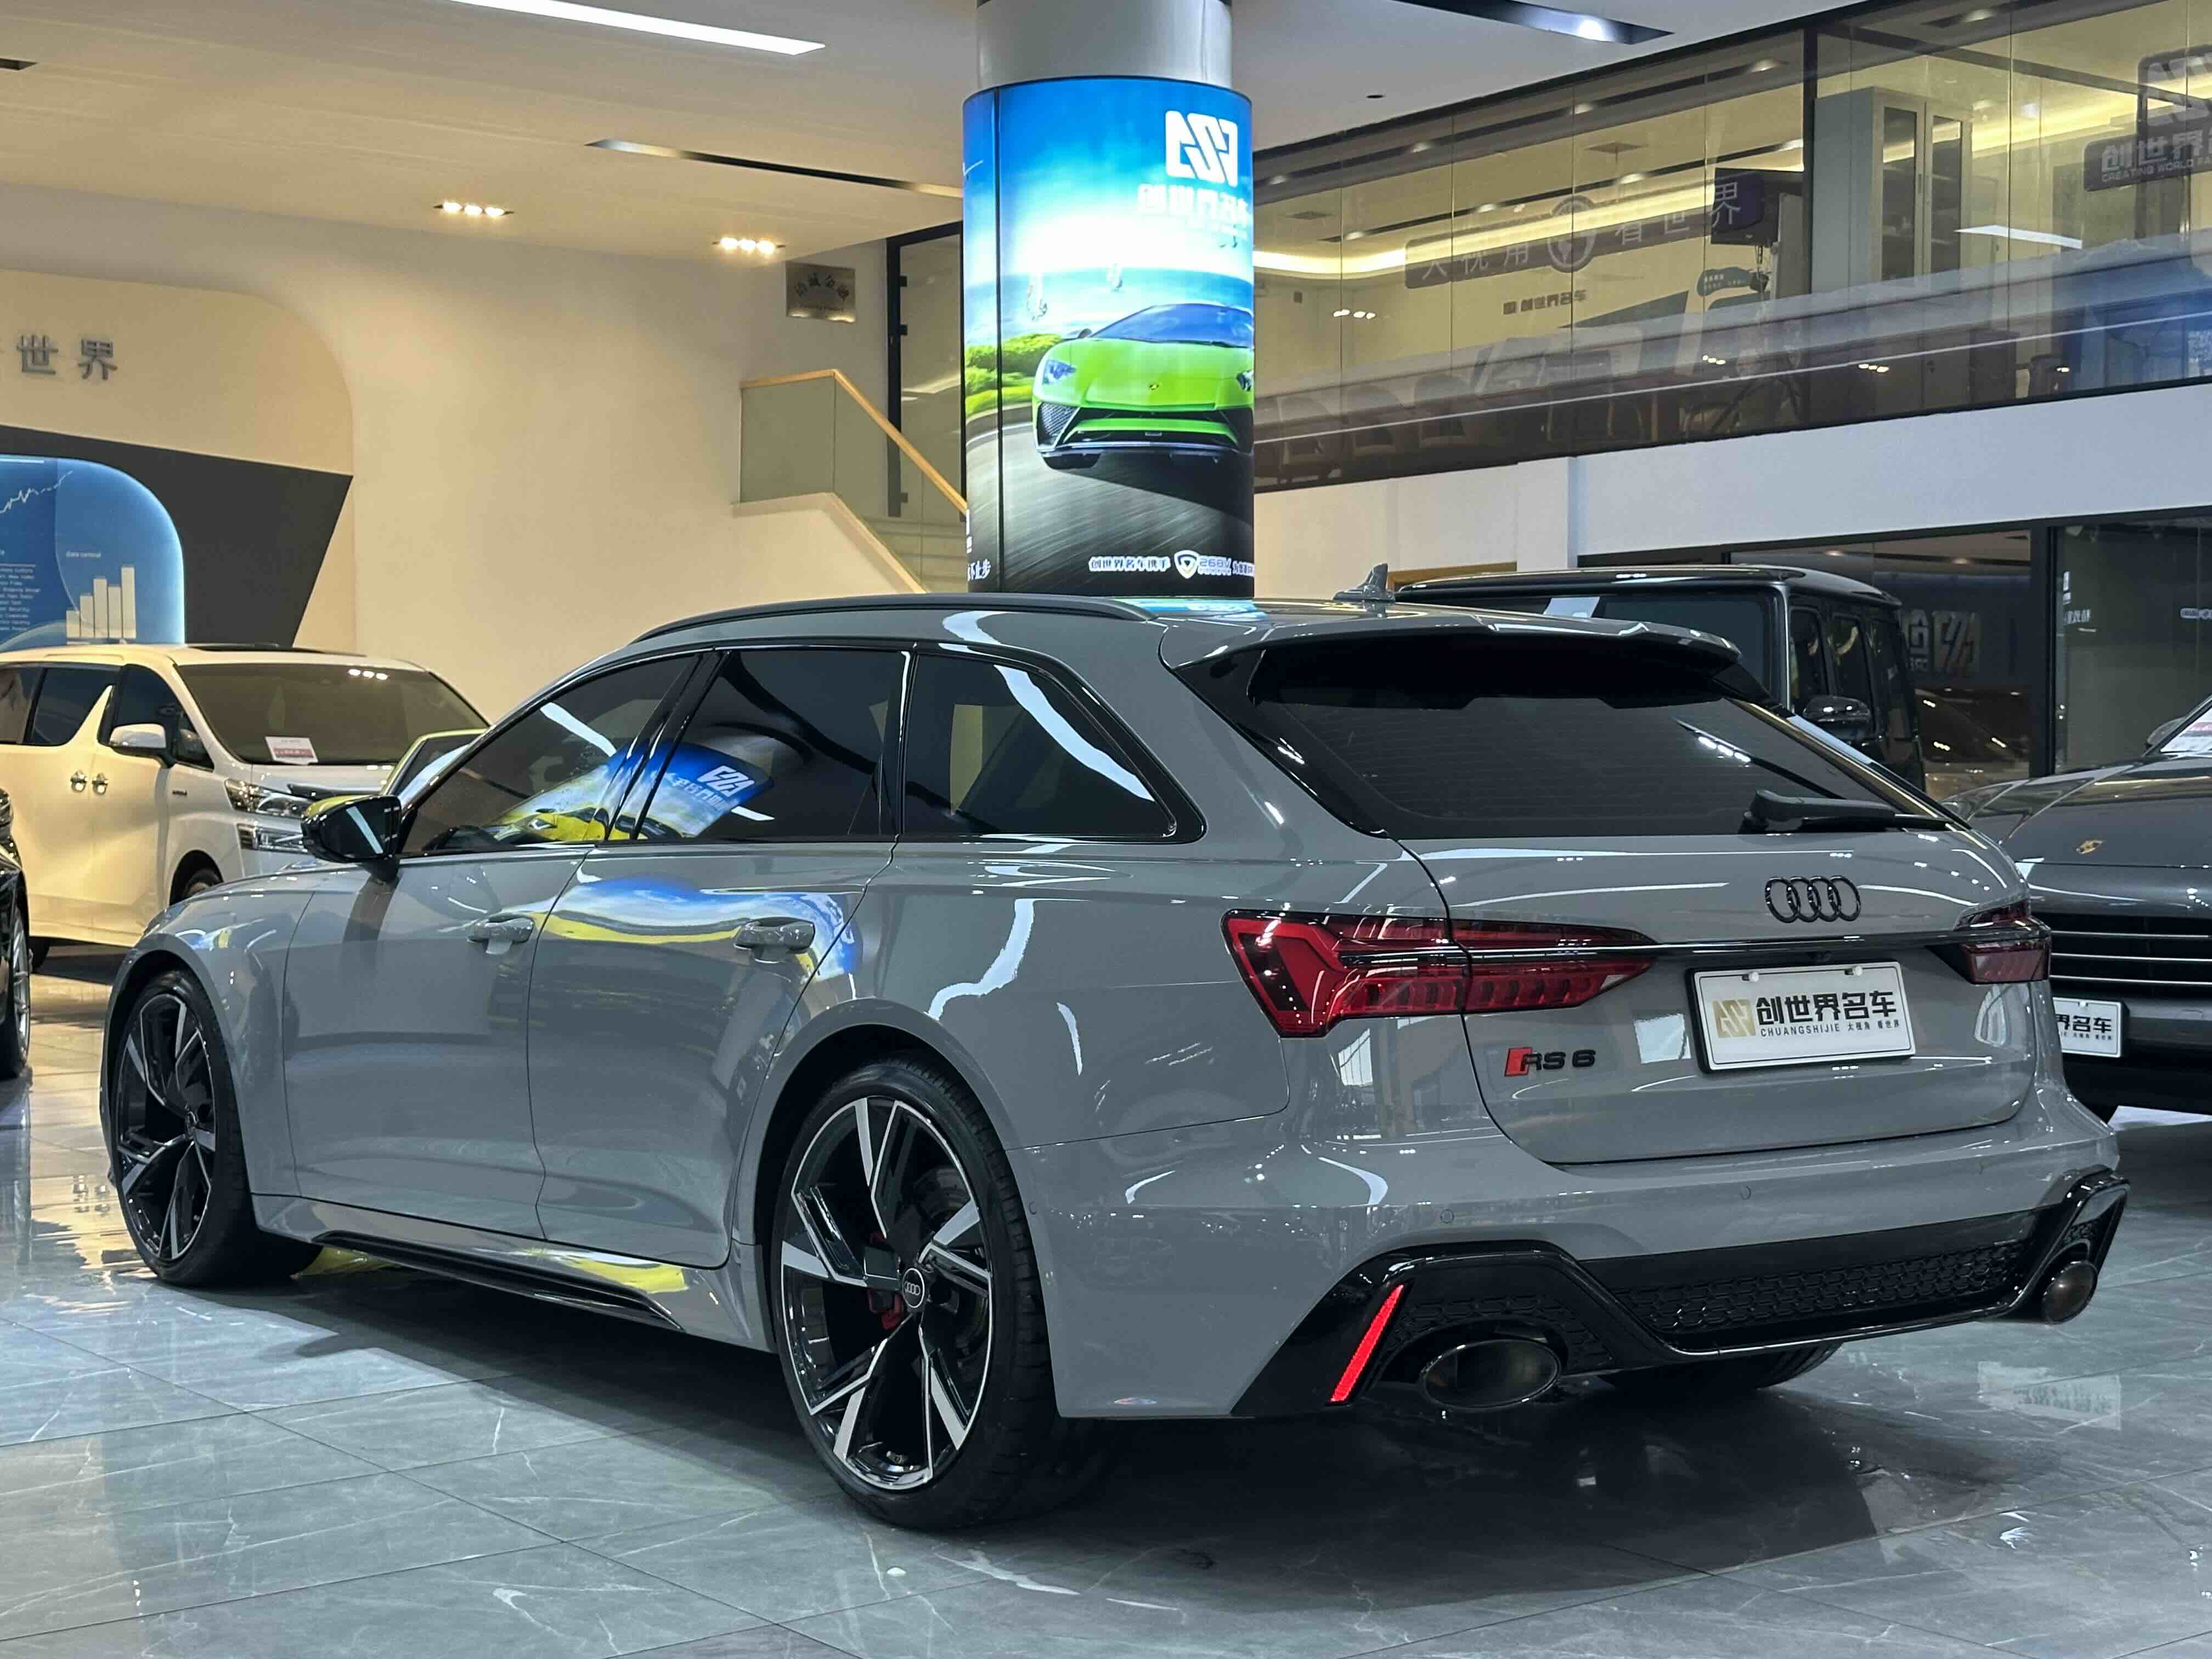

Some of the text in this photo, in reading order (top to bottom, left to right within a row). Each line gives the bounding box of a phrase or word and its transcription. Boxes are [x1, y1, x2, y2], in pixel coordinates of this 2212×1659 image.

[2101, 126, 2212, 173] 创世界
[1756, 990, 1896, 1025] 创世界名车
[1760, 1023, 1839, 1037] CHUANGSHIJIE
